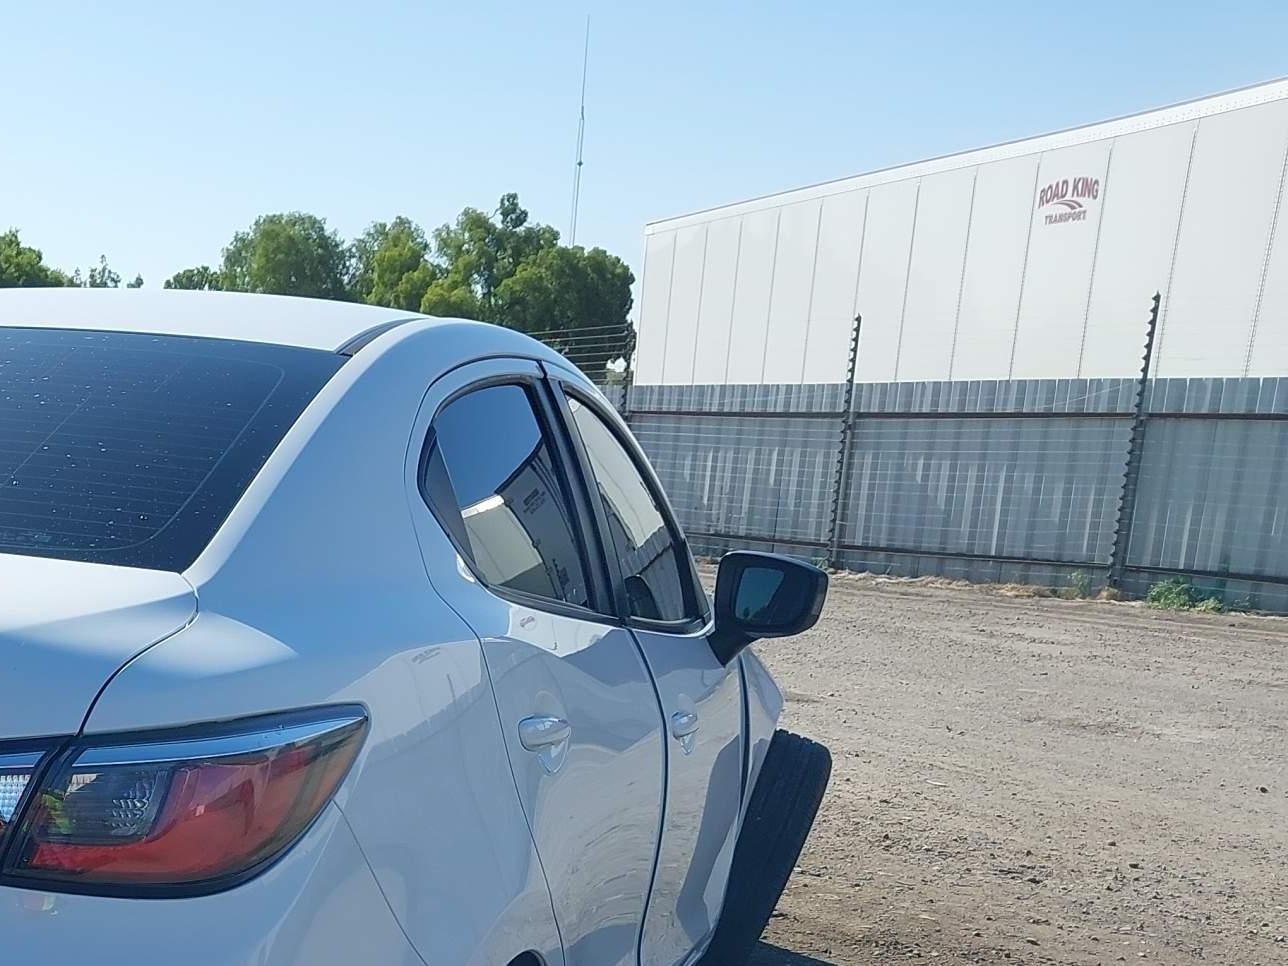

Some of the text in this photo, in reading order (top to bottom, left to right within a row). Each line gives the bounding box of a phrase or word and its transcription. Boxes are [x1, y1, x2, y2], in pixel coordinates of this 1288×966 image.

[1038, 176, 1100, 209] ROAD KING
[1044, 210, 1087, 225] TRANSPORT
